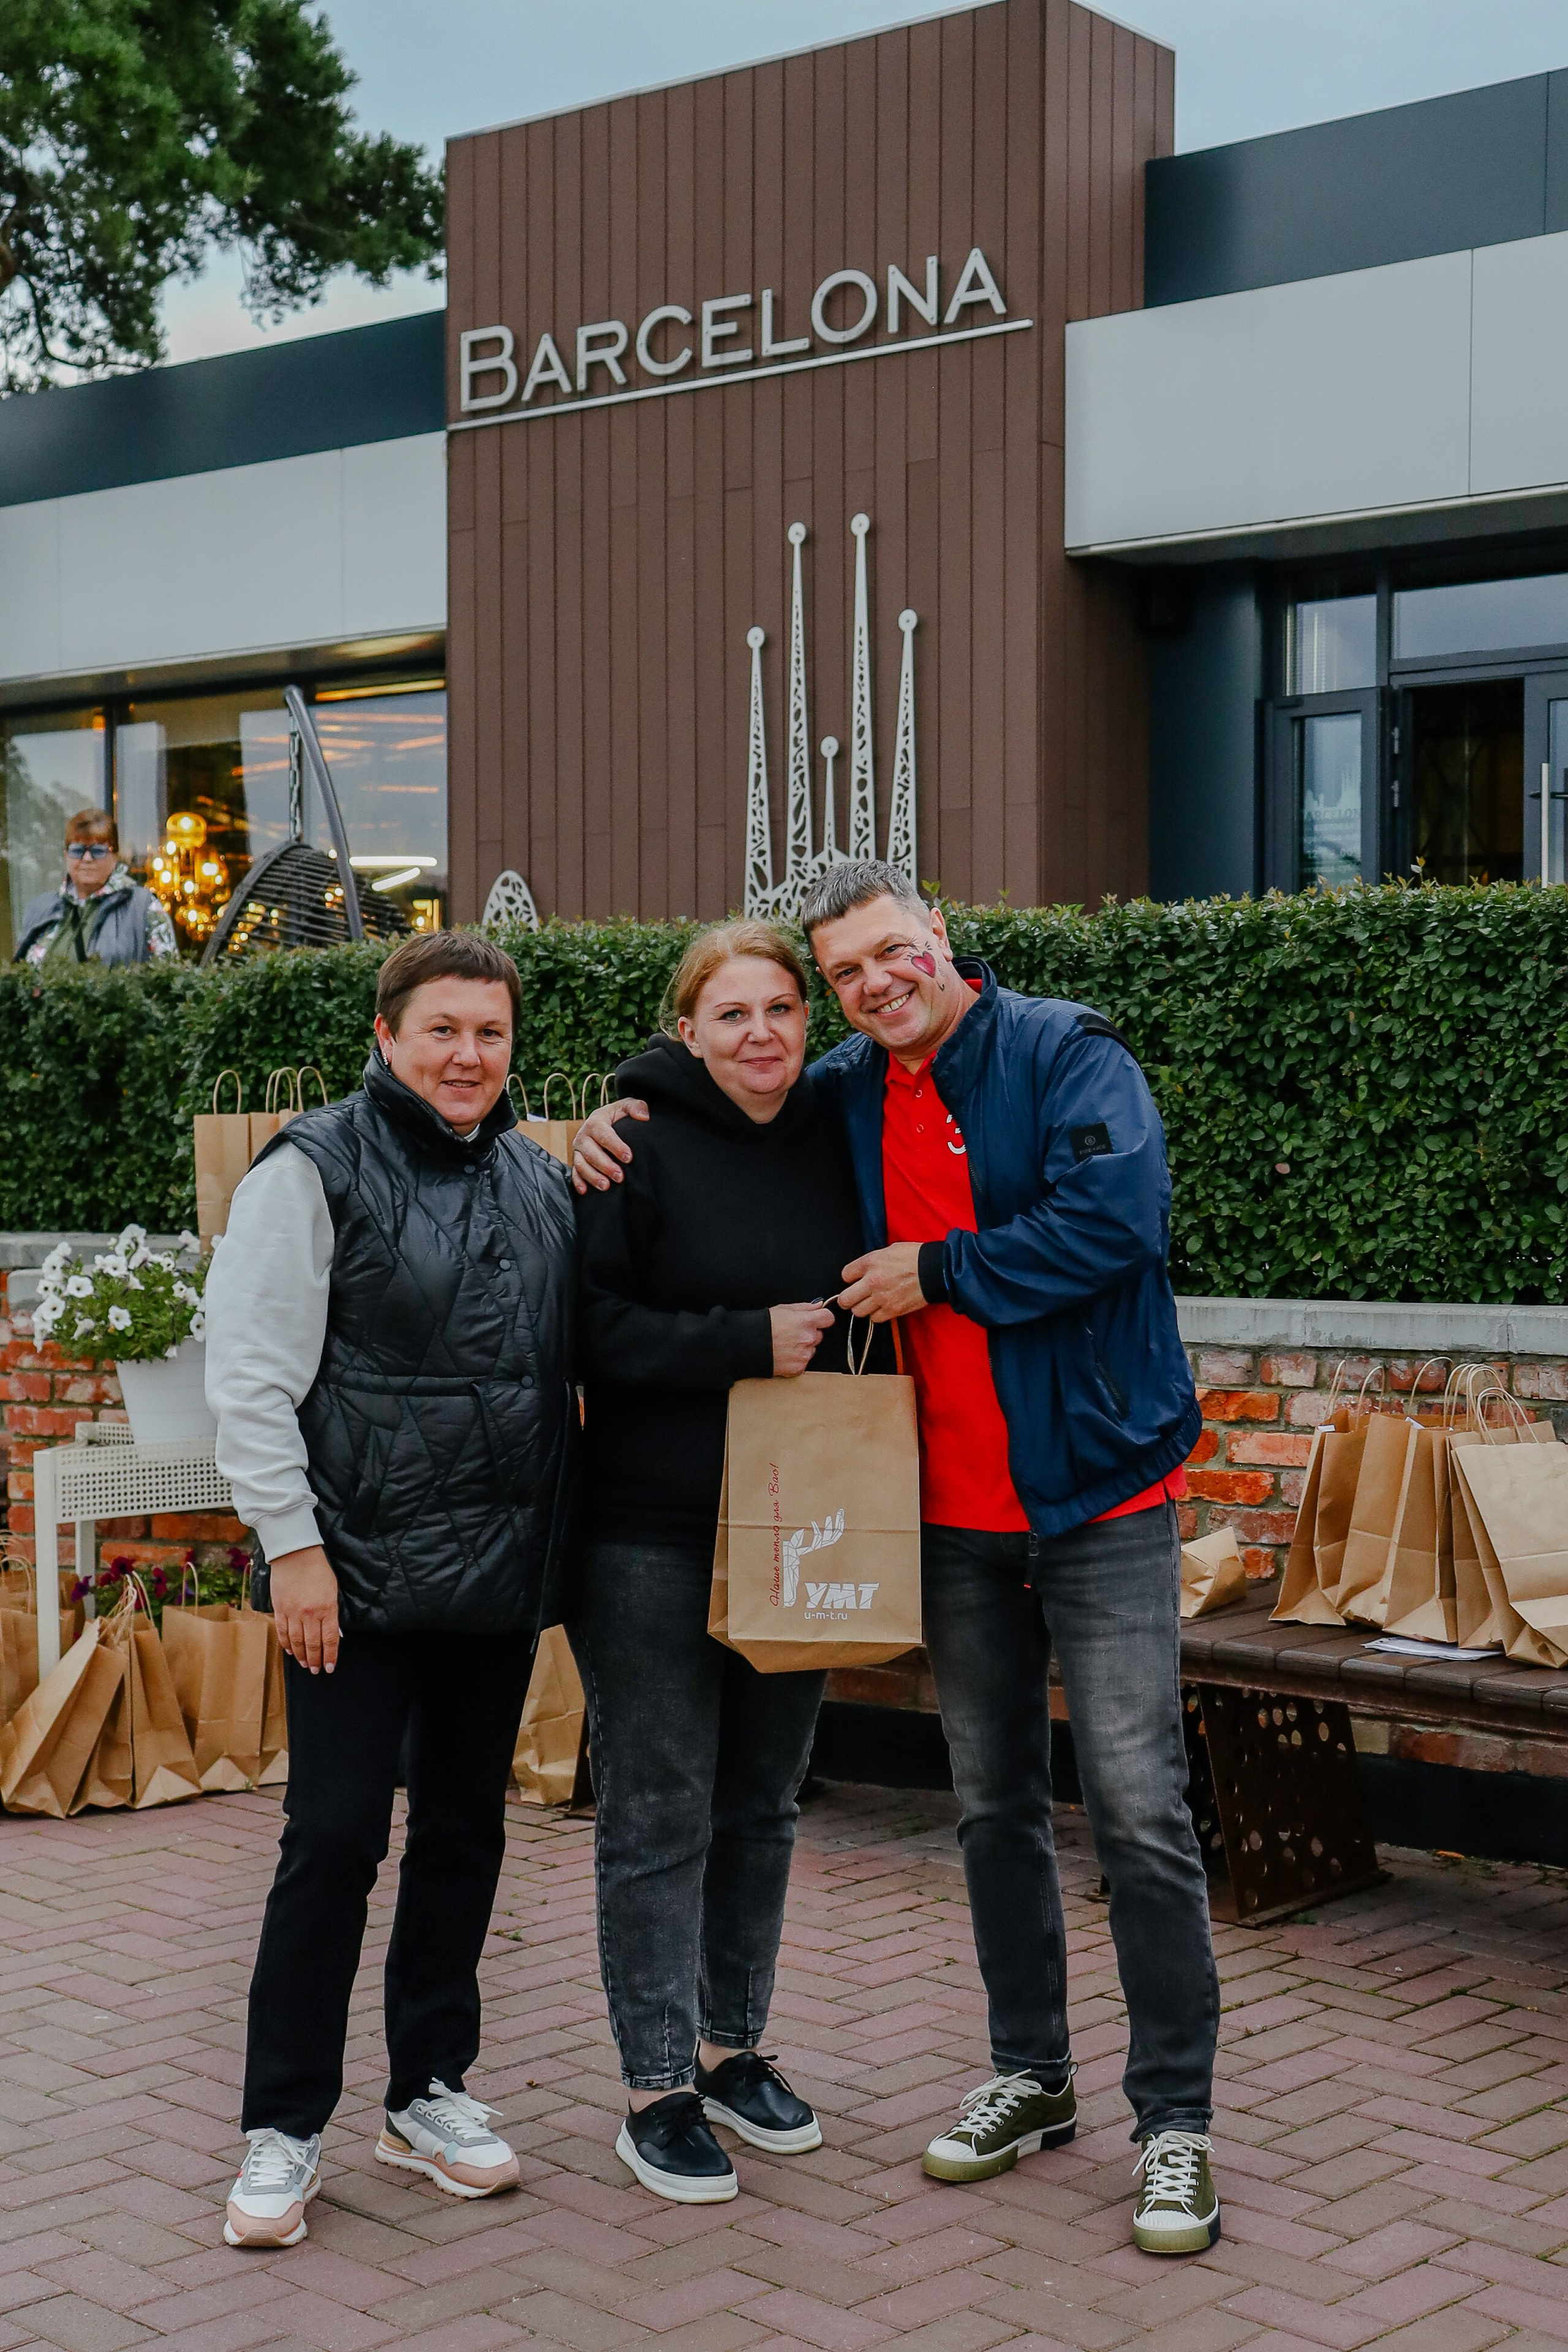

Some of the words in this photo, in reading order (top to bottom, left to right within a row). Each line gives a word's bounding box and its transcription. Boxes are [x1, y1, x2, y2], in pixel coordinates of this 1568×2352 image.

[459, 247, 1008, 413] BARCELONA
[773, 1499, 782, 1523] для
[769, 1566, 780, 1607] Наше
[804, 1582, 880, 1610] УМТ
[804, 1611, 848, 1621] u-m-t.ru
